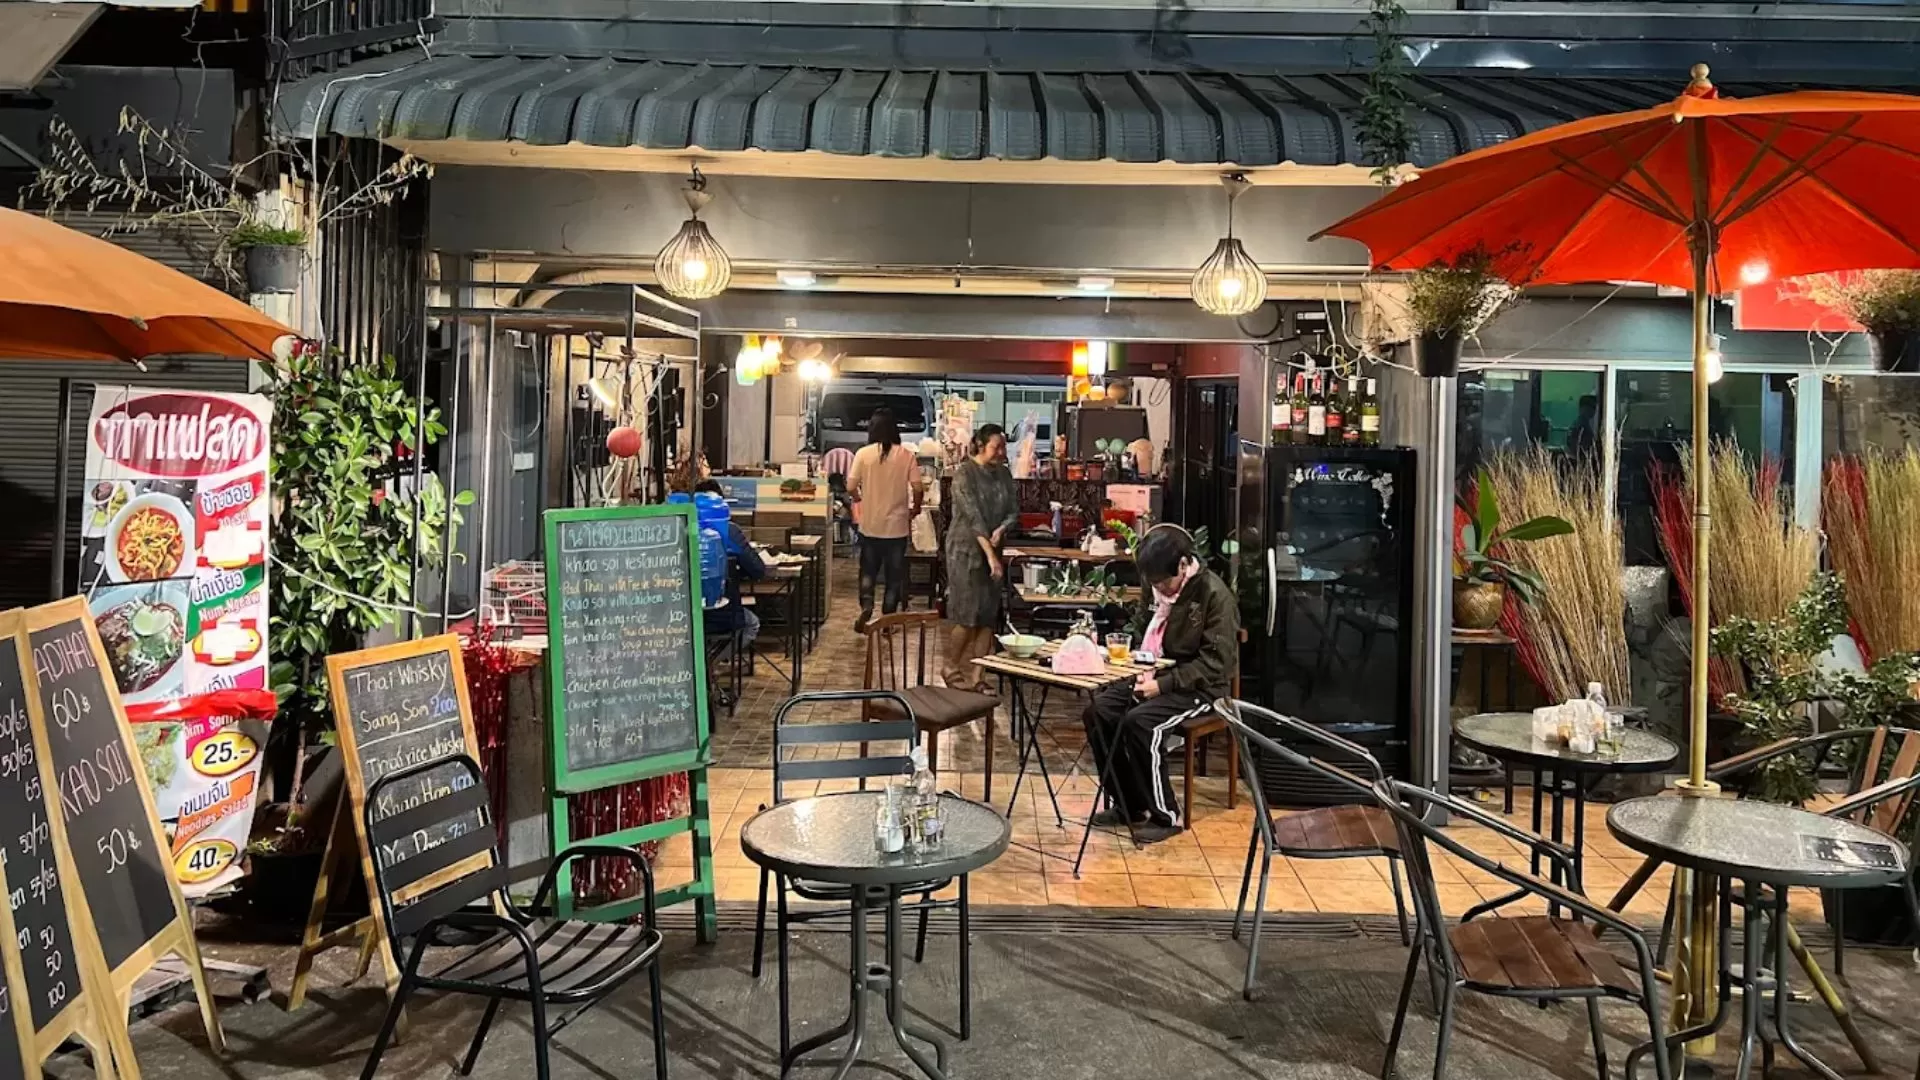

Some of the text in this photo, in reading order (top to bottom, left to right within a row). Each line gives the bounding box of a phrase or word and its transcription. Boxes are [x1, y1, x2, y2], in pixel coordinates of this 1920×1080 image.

[349, 658, 448, 697] Thai Whisky
[25, 776, 41, 802] 65
[184, 780, 230, 816] ขนมจีน
[39, 924, 54, 950] 50
[46, 950, 62, 977] 50
[47, 980, 66, 1008] 100
